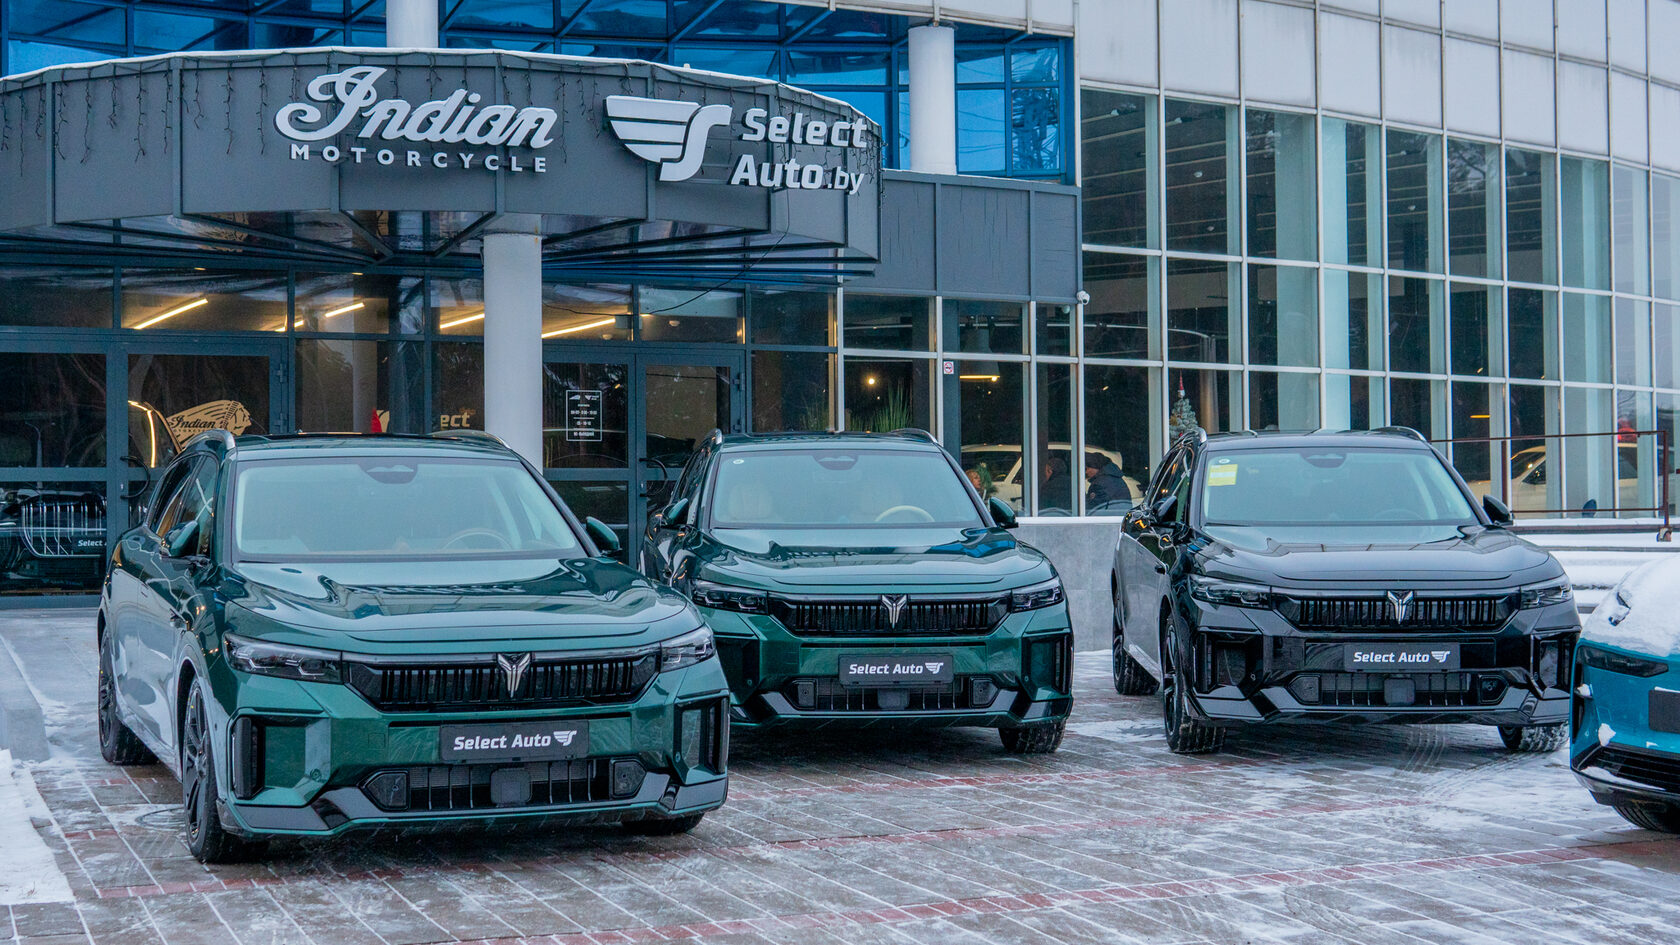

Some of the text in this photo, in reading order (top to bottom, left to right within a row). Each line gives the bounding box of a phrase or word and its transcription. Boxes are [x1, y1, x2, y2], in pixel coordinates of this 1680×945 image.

[275, 65, 557, 149] Indian
[741, 107, 868, 148] Select
[290, 144, 548, 174] MOTORCYCLE
[169, 415, 216, 429] Indian
[77, 540, 104, 548] Select
[1353, 652, 1430, 663] Select Auto
[848, 663, 924, 675] Select Auto
[453, 733, 552, 751] Select Auto
